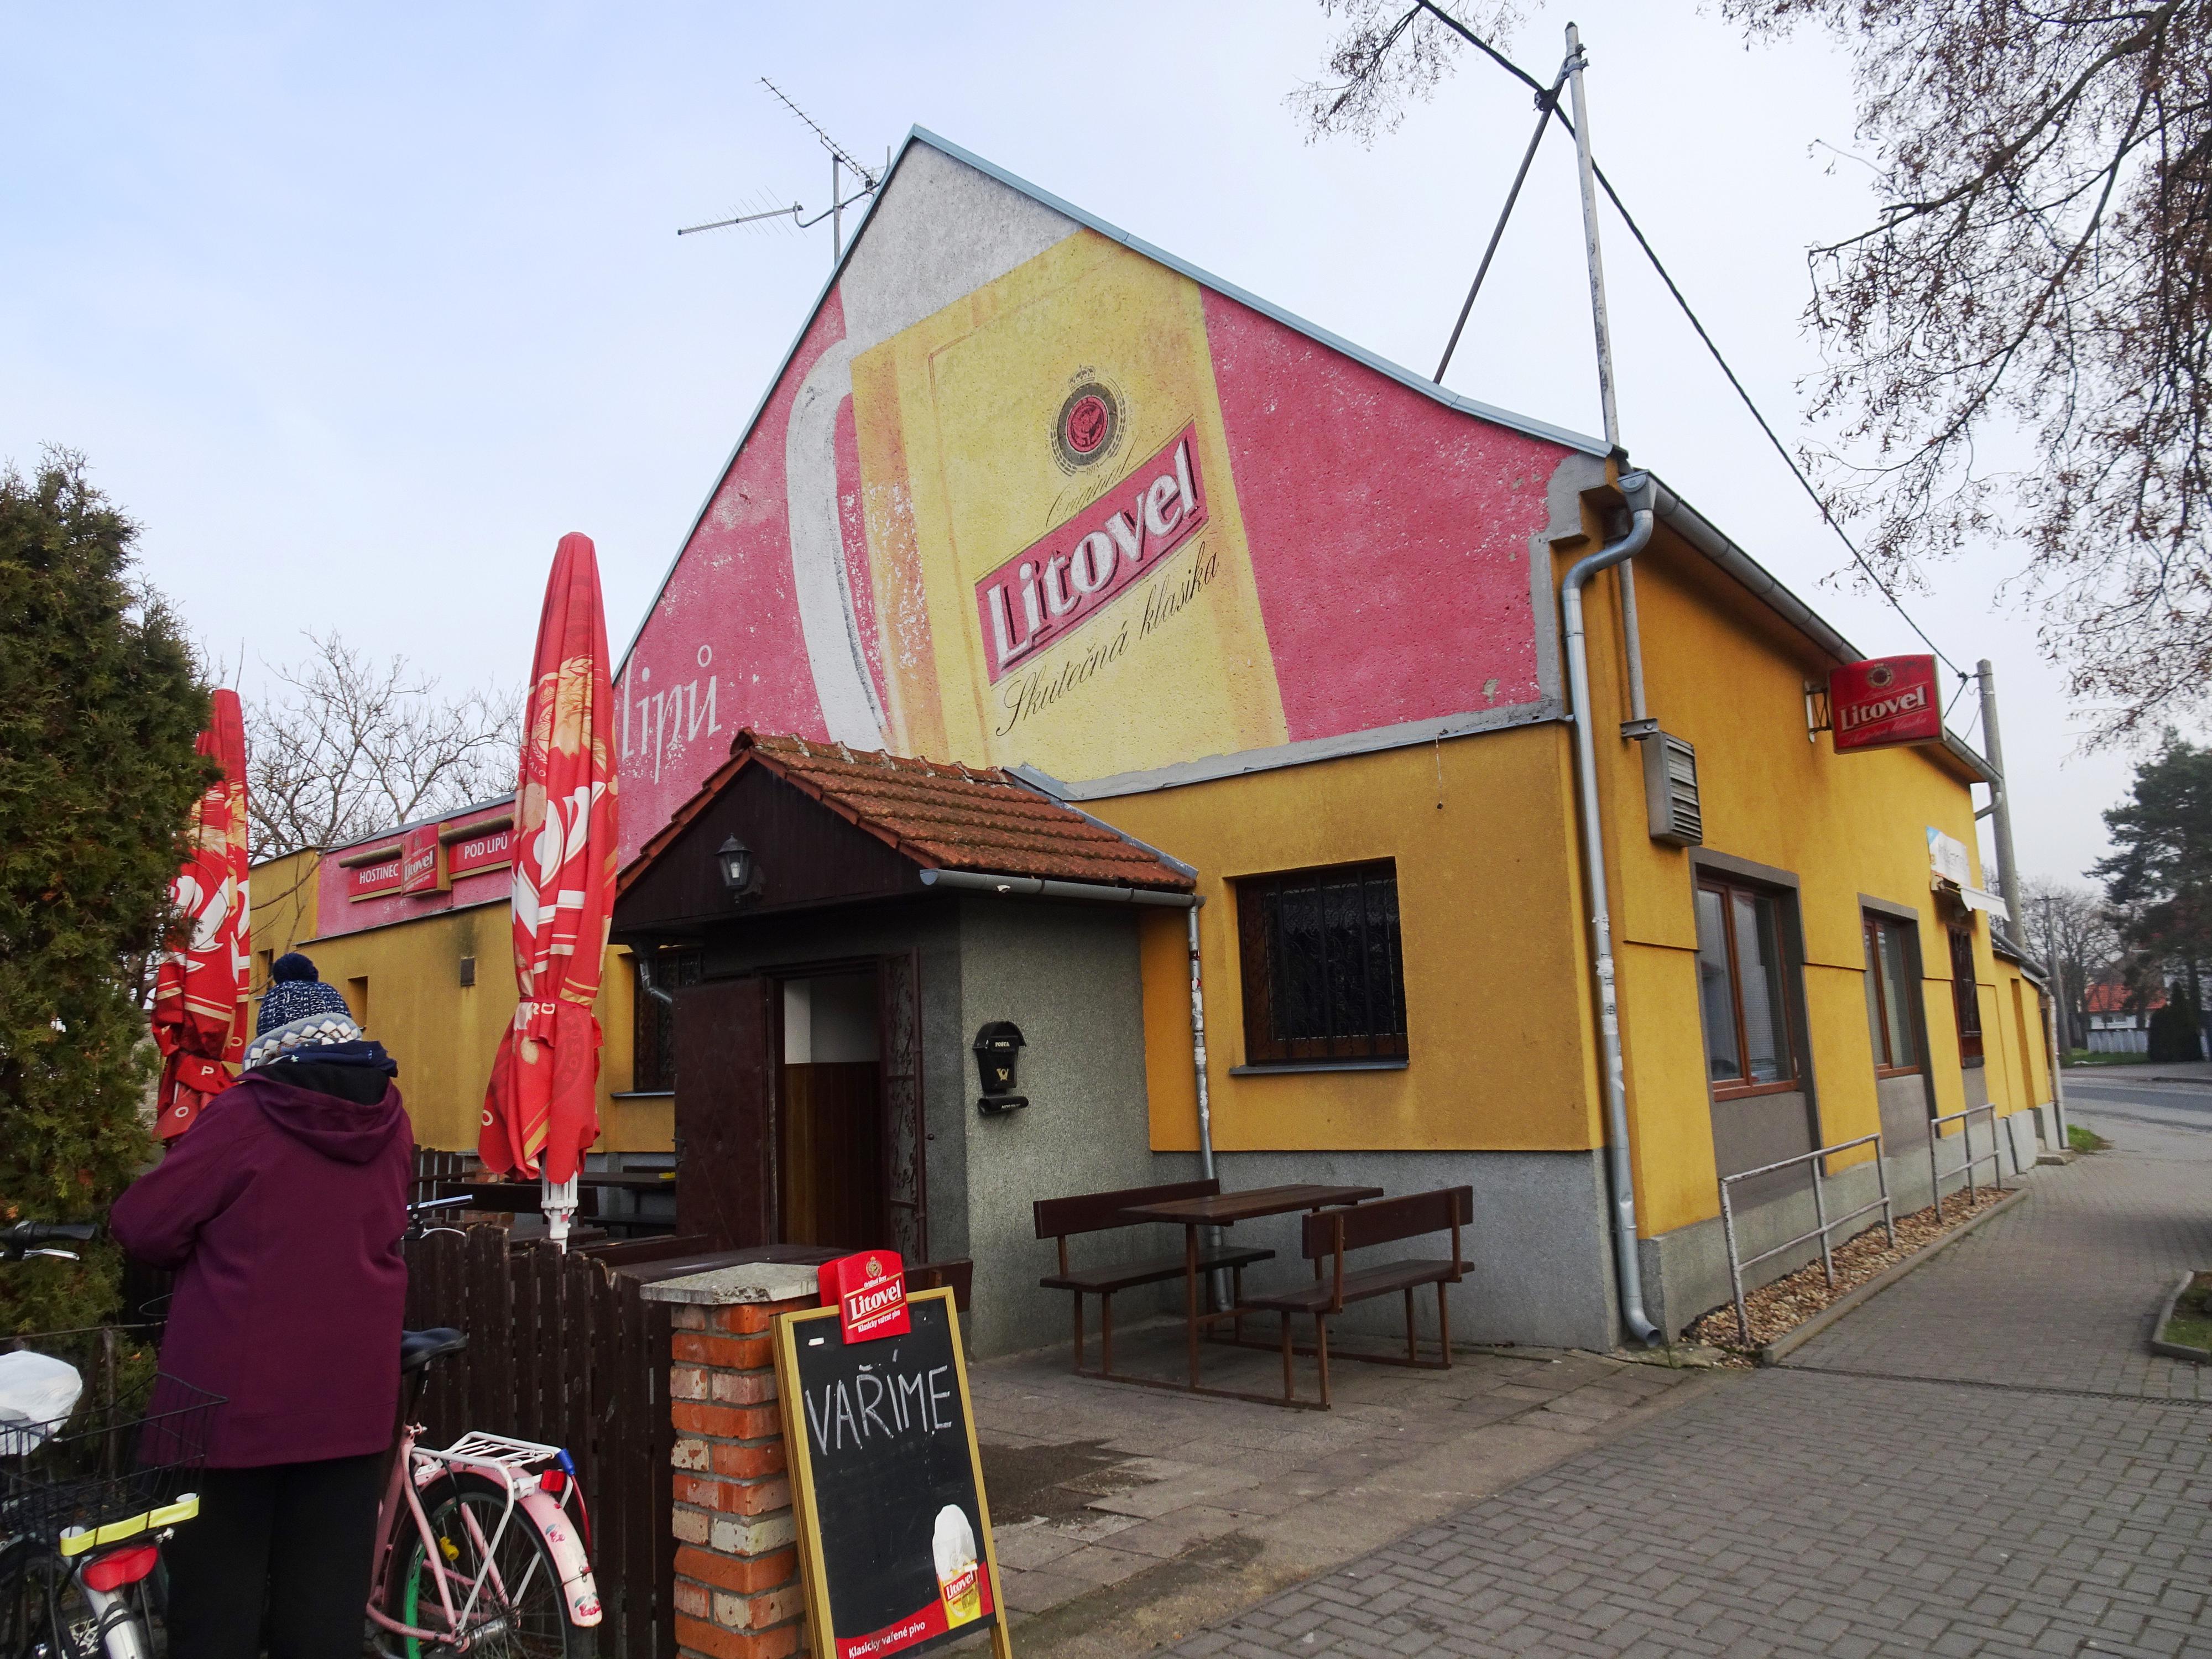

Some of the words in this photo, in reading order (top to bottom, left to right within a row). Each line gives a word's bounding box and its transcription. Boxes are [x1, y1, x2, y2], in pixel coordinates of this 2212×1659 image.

[987, 435, 1199, 665] Litovel
[995, 620, 1130, 736] Skutečná
[1139, 540, 1219, 640] klasika
[1840, 685, 1927, 731] Litovel
[404, 849, 433, 881] Litovel
[464, 841, 485, 860] POD
[487, 831, 508, 854] LIPŮ
[359, 863, 399, 885] HOSTINEC
[849, 1279, 902, 1321] Litovel
[805, 1348, 953, 1456] VAŘÍME
[946, 1571, 974, 1600] Litovel
[848, 1639, 881, 1659] Klasicky
[909, 1621, 926, 1638] pivo
